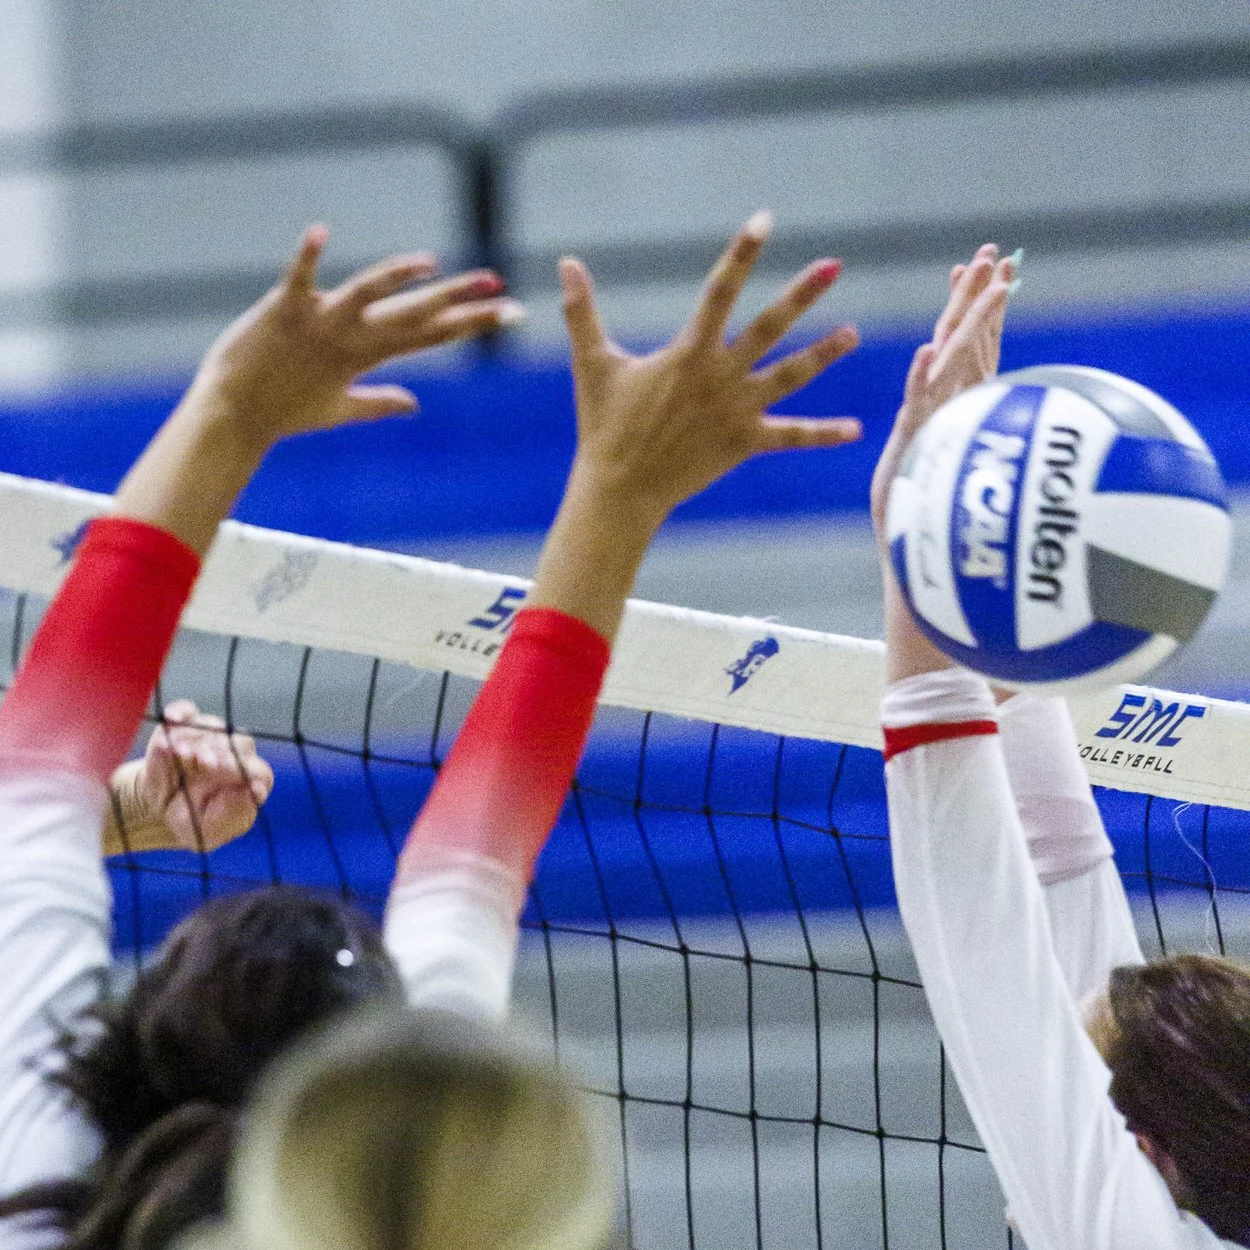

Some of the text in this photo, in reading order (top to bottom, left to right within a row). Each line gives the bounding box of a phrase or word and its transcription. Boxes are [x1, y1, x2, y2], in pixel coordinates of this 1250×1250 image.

[960, 431, 1027, 578] NCAA
[1027, 425, 1083, 603] molten
[1077, 744, 1175, 774] OLLEYBALL
[1094, 693, 1206, 747] SMC
